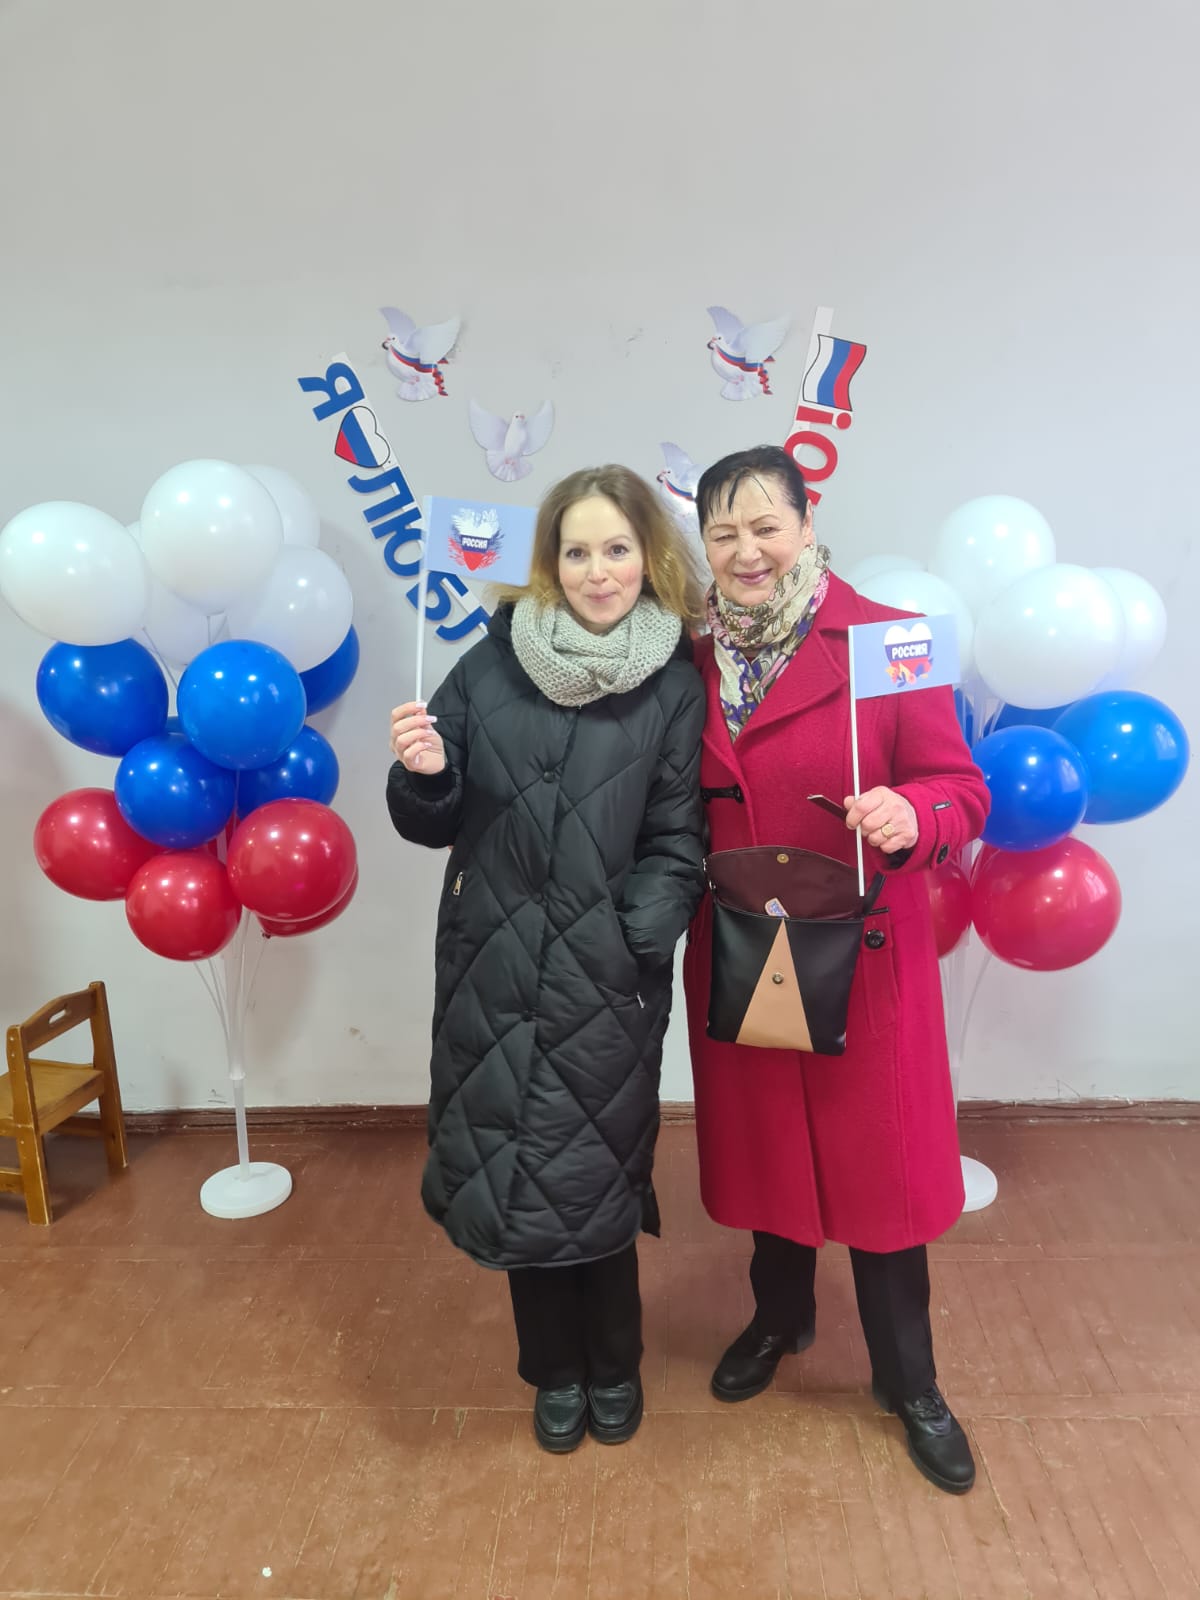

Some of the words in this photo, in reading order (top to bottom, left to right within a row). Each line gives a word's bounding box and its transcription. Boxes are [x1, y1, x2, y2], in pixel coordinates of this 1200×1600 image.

[297, 362, 365, 422] Я
[461, 537, 488, 550] РОССИЯ
[891, 642, 928, 660] РОССИЯ
